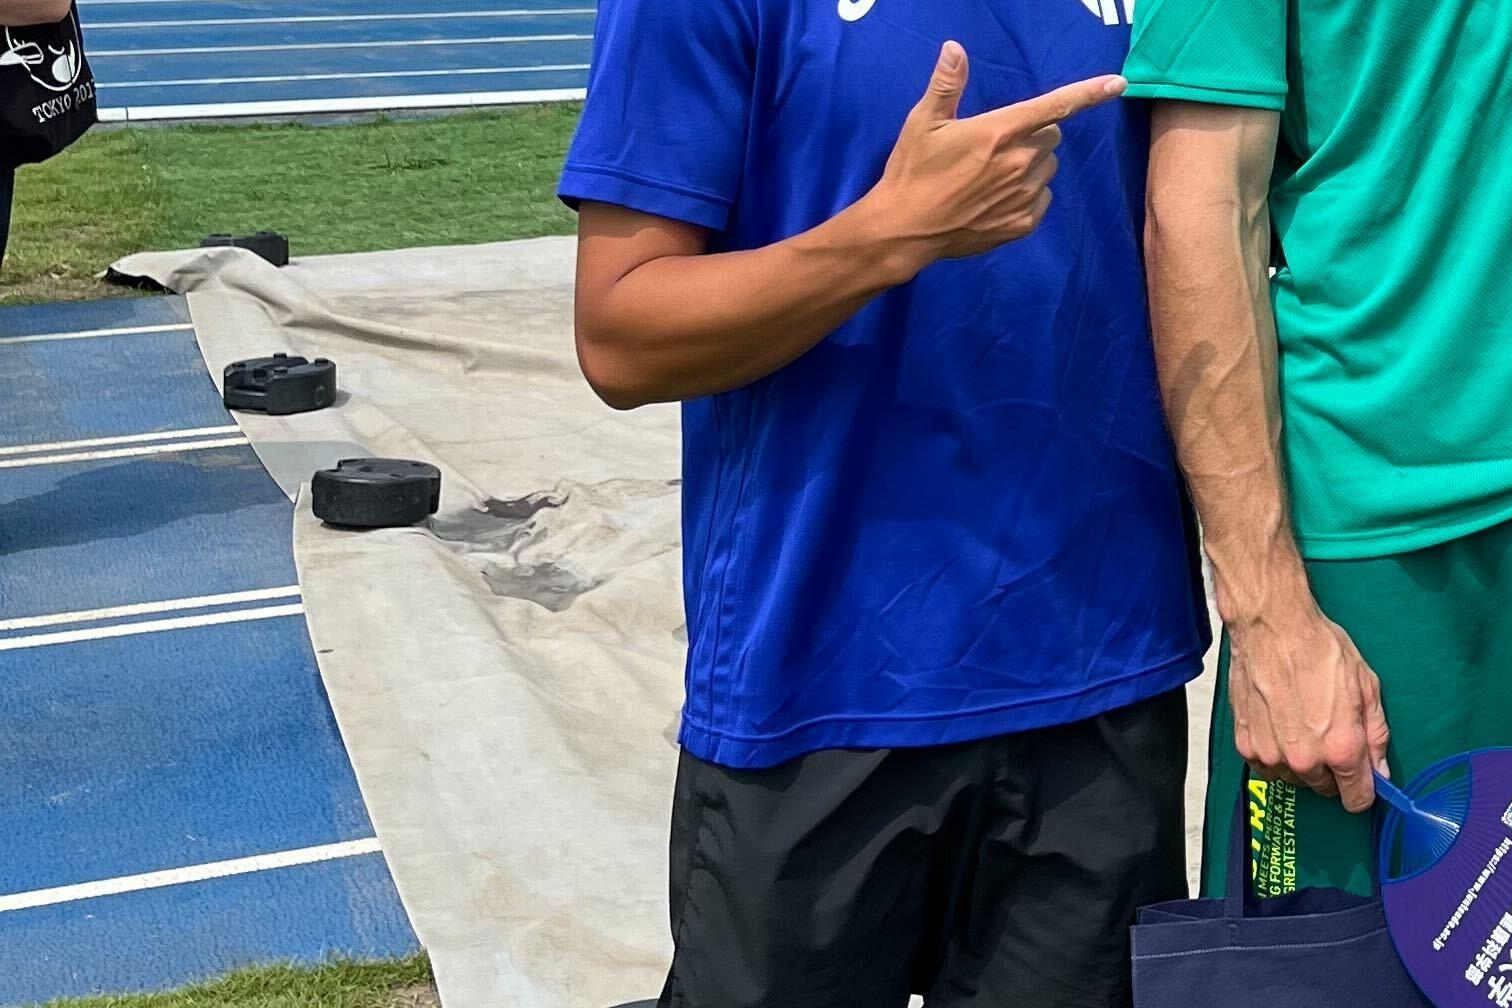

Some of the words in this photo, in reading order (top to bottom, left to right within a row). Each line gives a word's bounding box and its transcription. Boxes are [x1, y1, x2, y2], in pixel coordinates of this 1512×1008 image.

[31, 93, 72, 123] TOKYO
[73, 78, 95, 111] 201
[1274, 804, 1283, 813] &
[1284, 782, 1296, 829] ATHLE
[1258, 843, 1270, 890] MEETS
[1270, 815, 1282, 884] FORWARD
[1283, 829, 1296, 895] GREATEST
